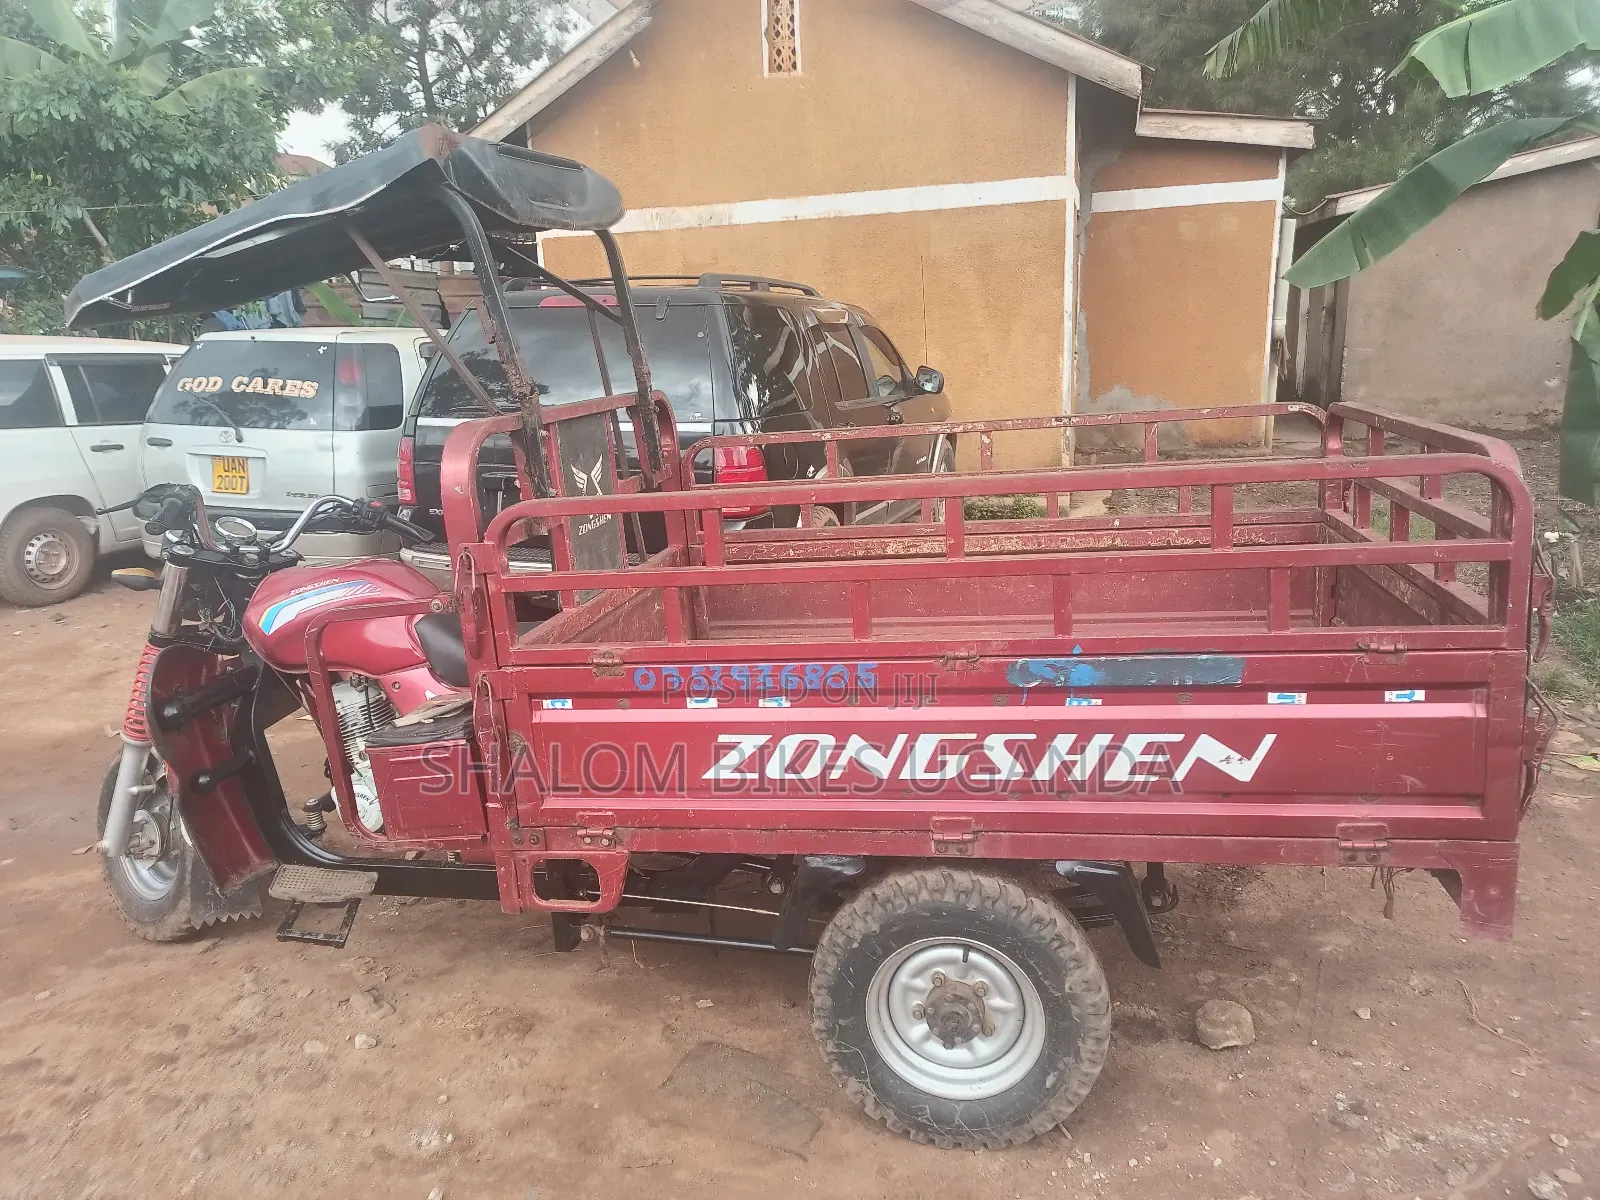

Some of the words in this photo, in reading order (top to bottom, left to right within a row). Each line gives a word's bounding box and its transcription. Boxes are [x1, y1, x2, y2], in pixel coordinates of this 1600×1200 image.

[177, 376, 223, 393] GOD
[231, 376, 319, 398] CARES
[222, 457, 246, 474] UAN
[578, 513, 612, 536] ZONGSHEN
[701, 732, 1278, 782] ZONGSHEN
